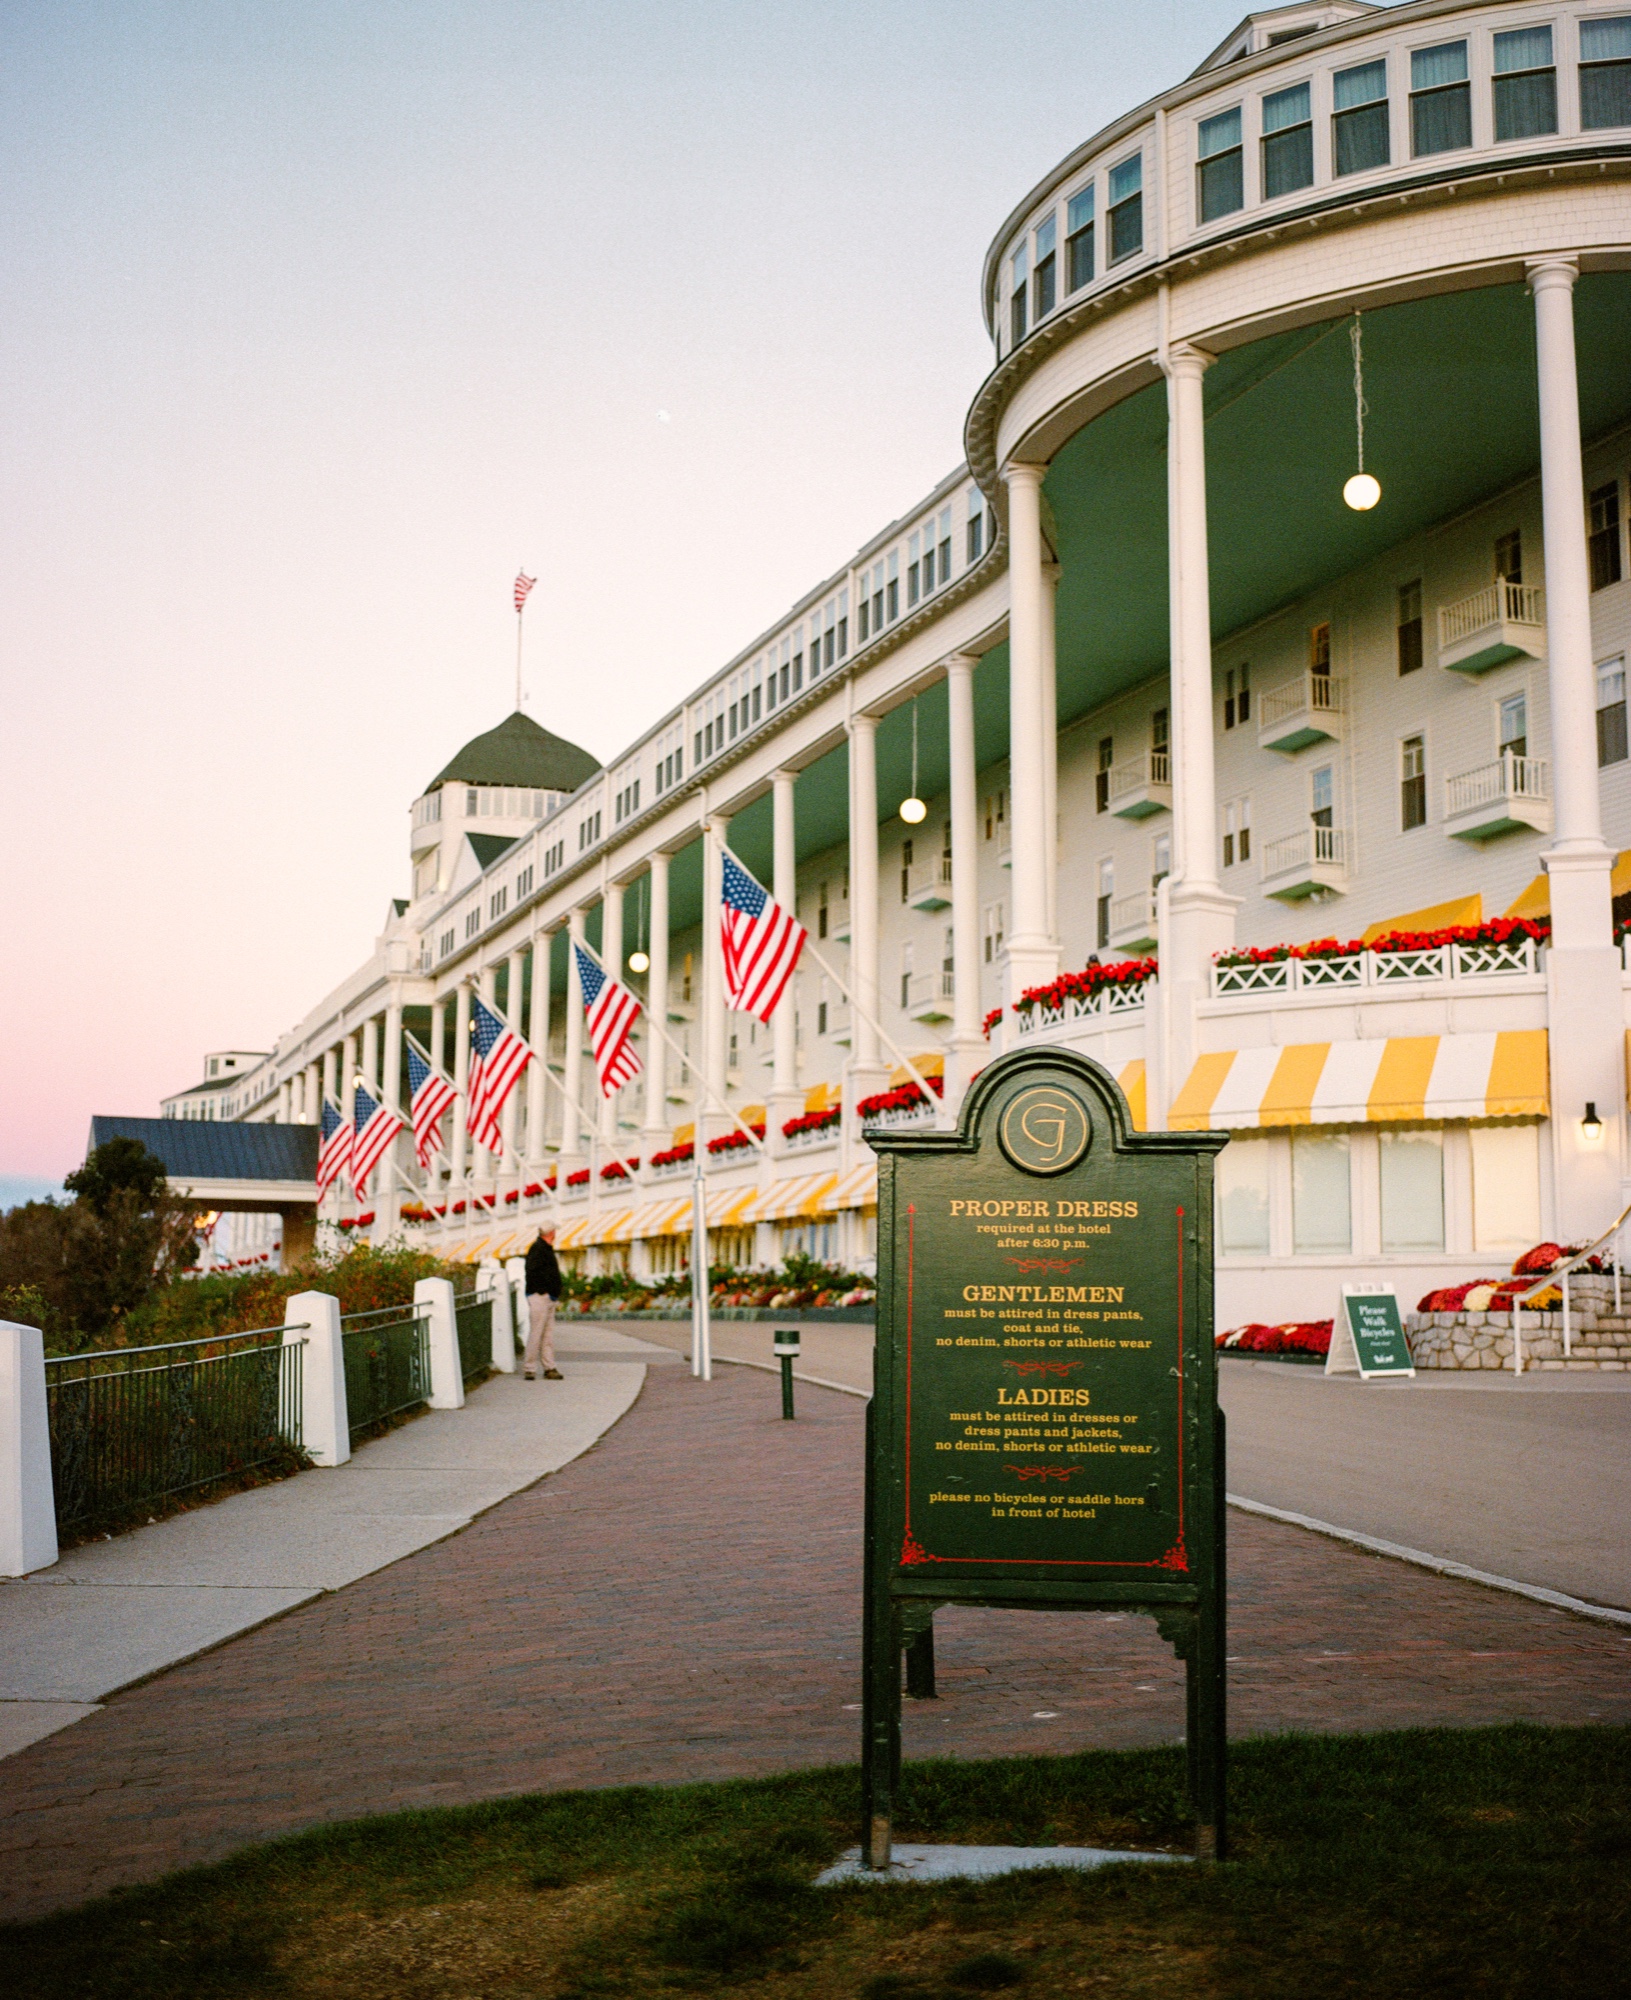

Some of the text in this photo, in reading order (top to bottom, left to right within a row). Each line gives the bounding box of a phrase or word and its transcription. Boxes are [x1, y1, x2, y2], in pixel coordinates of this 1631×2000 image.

[950, 1200, 1139, 1217] PROPER DRESS
[976, 1223, 1111, 1235] required at the hotel
[997, 1238, 1090, 1250] after 6:30 p.m.
[962, 1285, 1125, 1303] GENTLEMEN
[944, 1308, 1144, 1321] must be attired in dress pants,
[1359, 1305, 1387, 1315] Please
[1363, 1316, 1387, 1326] Walk
[1003, 1323, 1084, 1335] coat and tie,
[1360, 1327, 1395, 1339] Bicycles
[936, 1337, 1153, 1348] no denim, shorts or athletic wear
[997, 1388, 1090, 1406] LADIES
[950, 1411, 1138, 1423] must be attired in dresses or
[964, 1425, 1123, 1439] dress pants and jackets,
[935, 1440, 1153, 1453] no denim, shorts or athletic wear
[929, 1491, 971, 1504] please
[974, 1494, 991, 1502] no
[994, 1493, 1047, 1505] bicycles
[1050, 1495, 1065, 1504] or
[1067, 1495, 1111, 1504] saddle
[992, 1507, 1096, 1518] in front of hotel
